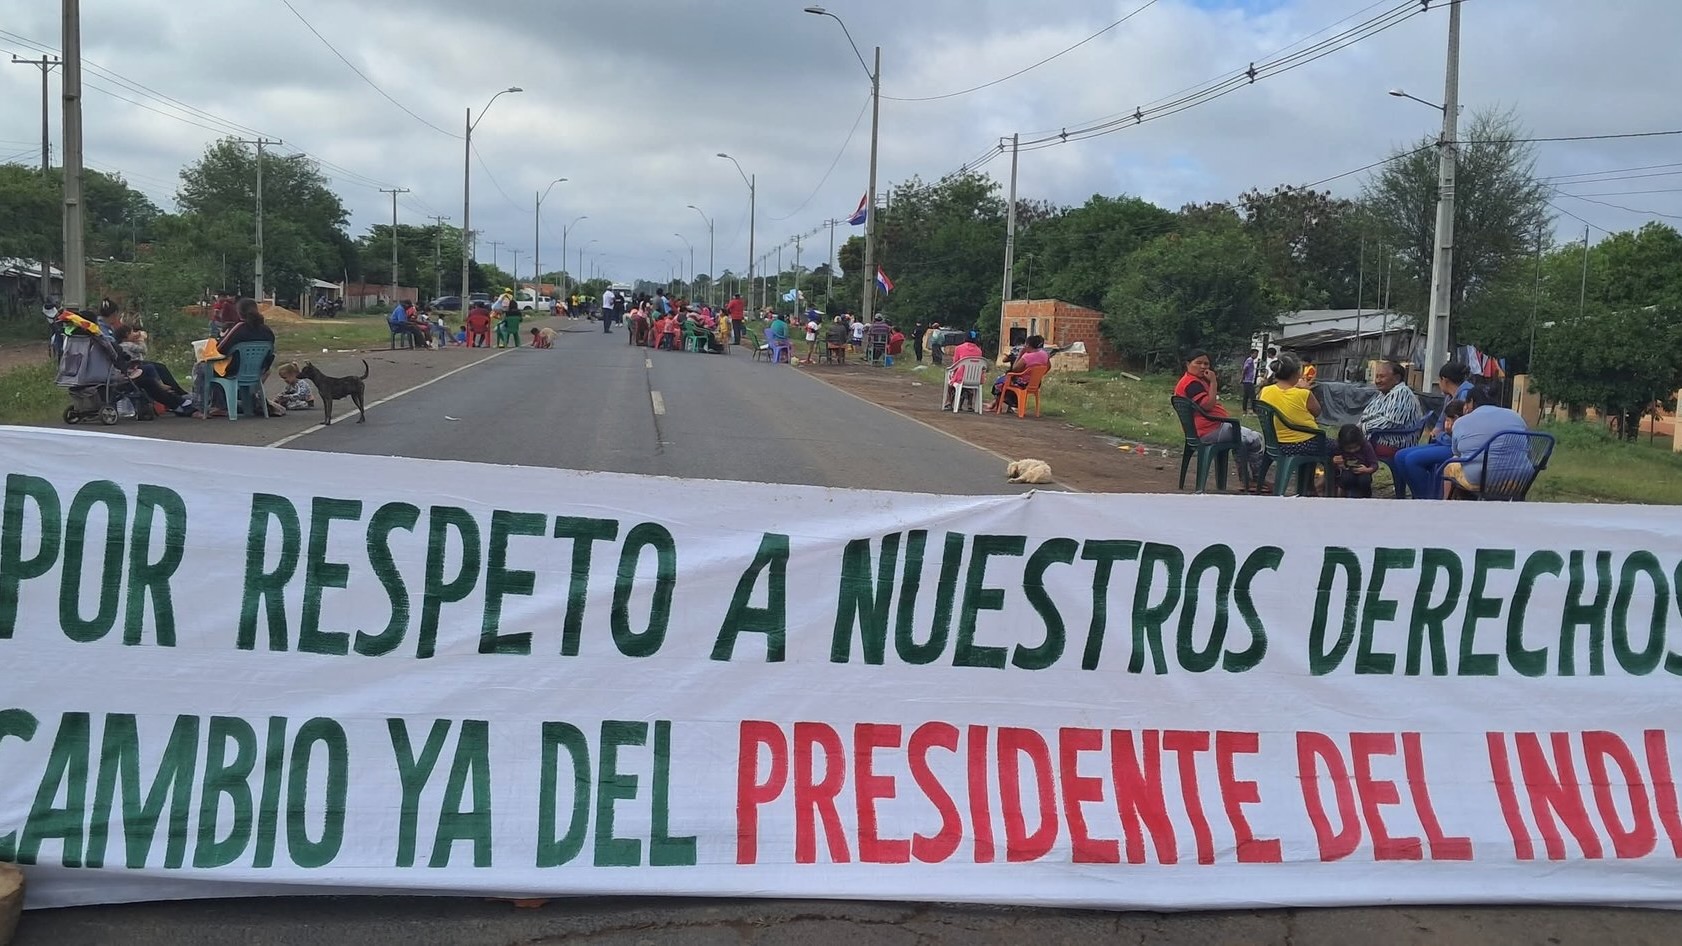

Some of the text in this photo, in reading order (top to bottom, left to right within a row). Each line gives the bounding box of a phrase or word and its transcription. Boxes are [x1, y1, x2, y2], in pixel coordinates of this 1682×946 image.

[0, 473, 187, 646] POR
[237, 493, 676, 658] RESPETO
[711, 532, 790, 662] A
[831, 530, 1285, 675] NUESTROS
[387, 718, 491, 868] YA
[537, 720, 697, 867] DEL
[736, 720, 1282, 864] PRESIDENTE
[1296, 731, 1472, 862] DEL
[1486, 729, 1682, 861] INDI
